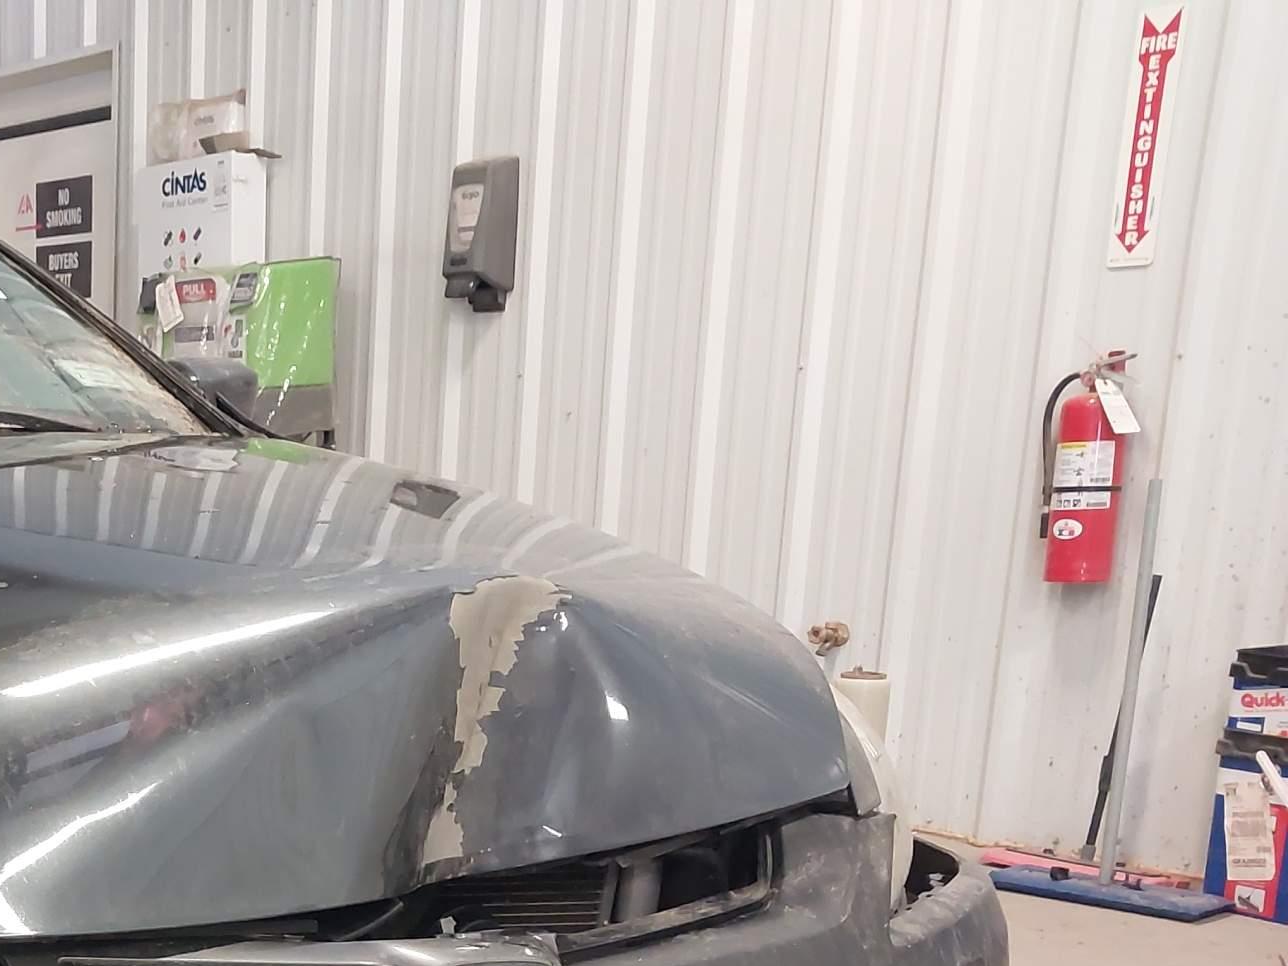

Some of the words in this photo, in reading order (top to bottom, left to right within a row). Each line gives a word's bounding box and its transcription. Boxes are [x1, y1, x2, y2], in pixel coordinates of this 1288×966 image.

[1141, 31, 1177, 55] FIRE
[1124, 54, 1161, 246] EXTINGUISHER
[58, 188, 70, 206] NO
[46, 207, 82, 228] SMOKING
[48, 251, 79, 271] BUYERS
[55, 273, 73, 288] XIT
[182, 283, 206, 297] PULL
